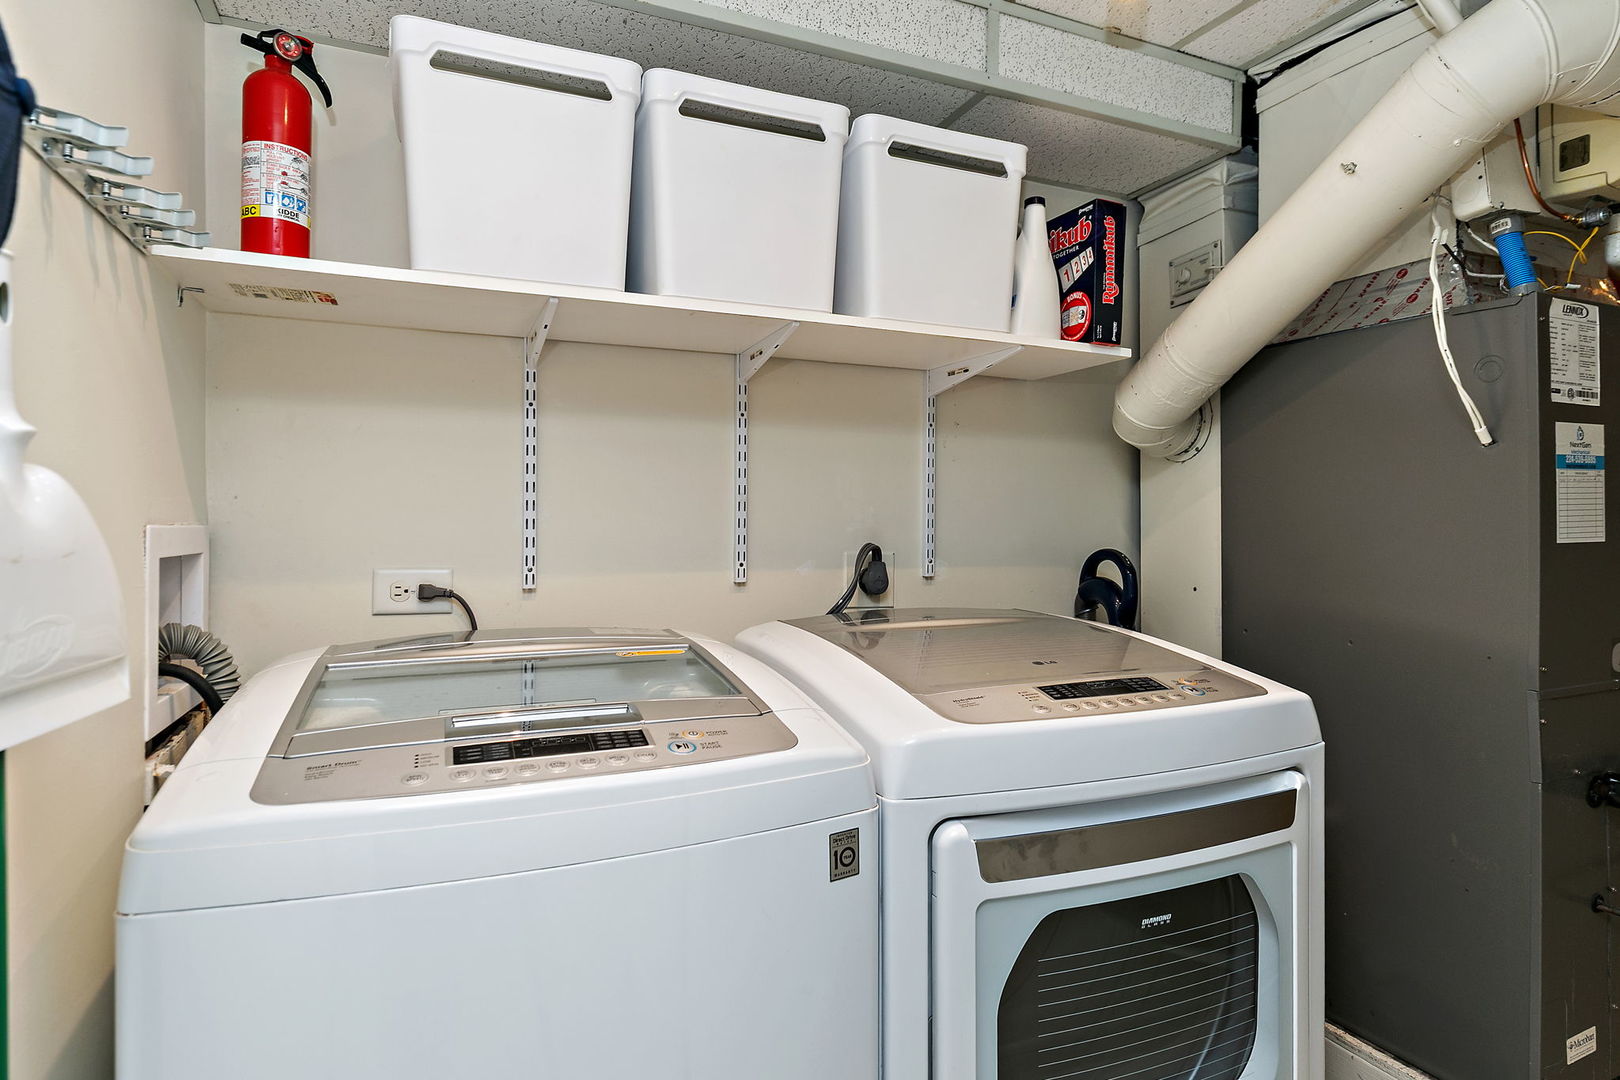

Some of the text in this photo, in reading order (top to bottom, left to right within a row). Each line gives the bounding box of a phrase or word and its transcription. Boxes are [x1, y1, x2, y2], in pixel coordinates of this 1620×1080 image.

[1063, 269, 1070, 282] 1
[1074, 261, 1080, 274] 2
[1082, 255, 1087, 266] 3
[1102, 216, 1120, 304] Rummikub
[833, 846, 856, 870] 10
[1141, 913, 1172, 925] DIAMOND
